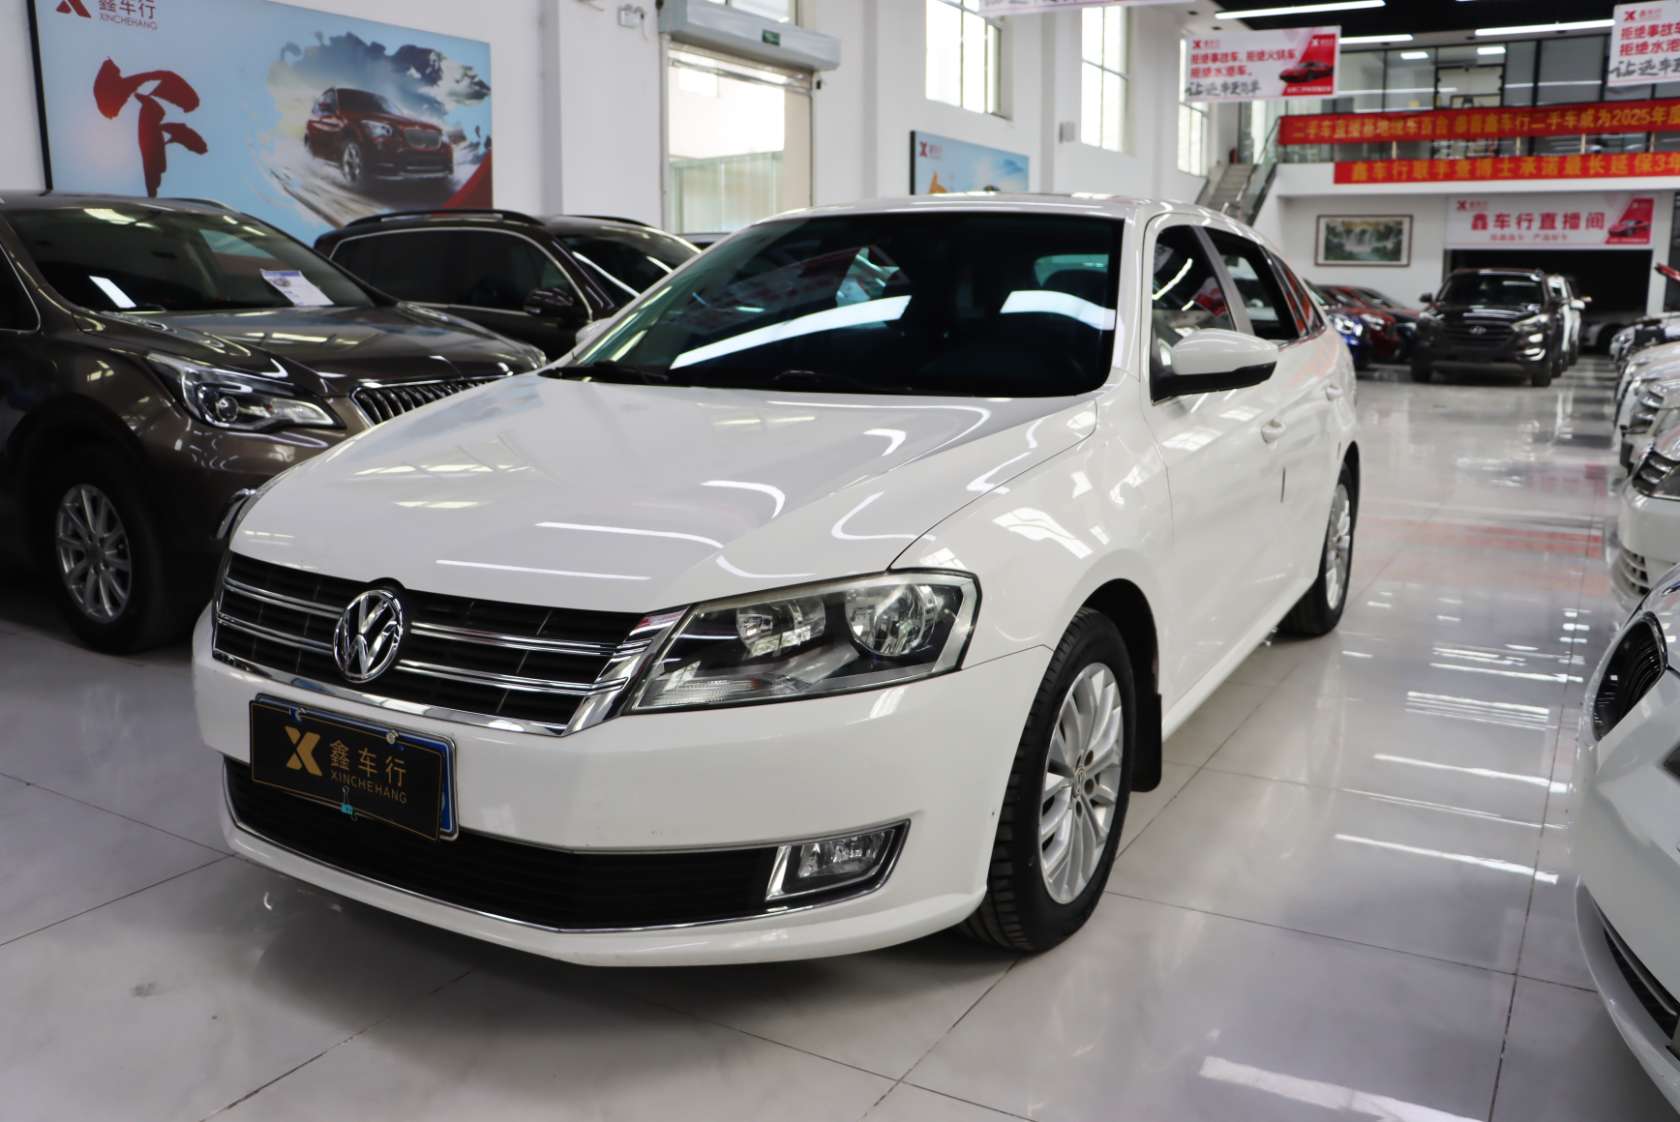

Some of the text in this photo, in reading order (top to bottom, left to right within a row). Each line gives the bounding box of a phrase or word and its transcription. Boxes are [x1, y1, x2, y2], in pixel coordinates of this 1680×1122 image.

[1471, 211, 1605, 231] 鑫车行直播间
[329, 739, 407, 788] 鑫车行
[330, 770, 408, 805] XINCHEHANG
